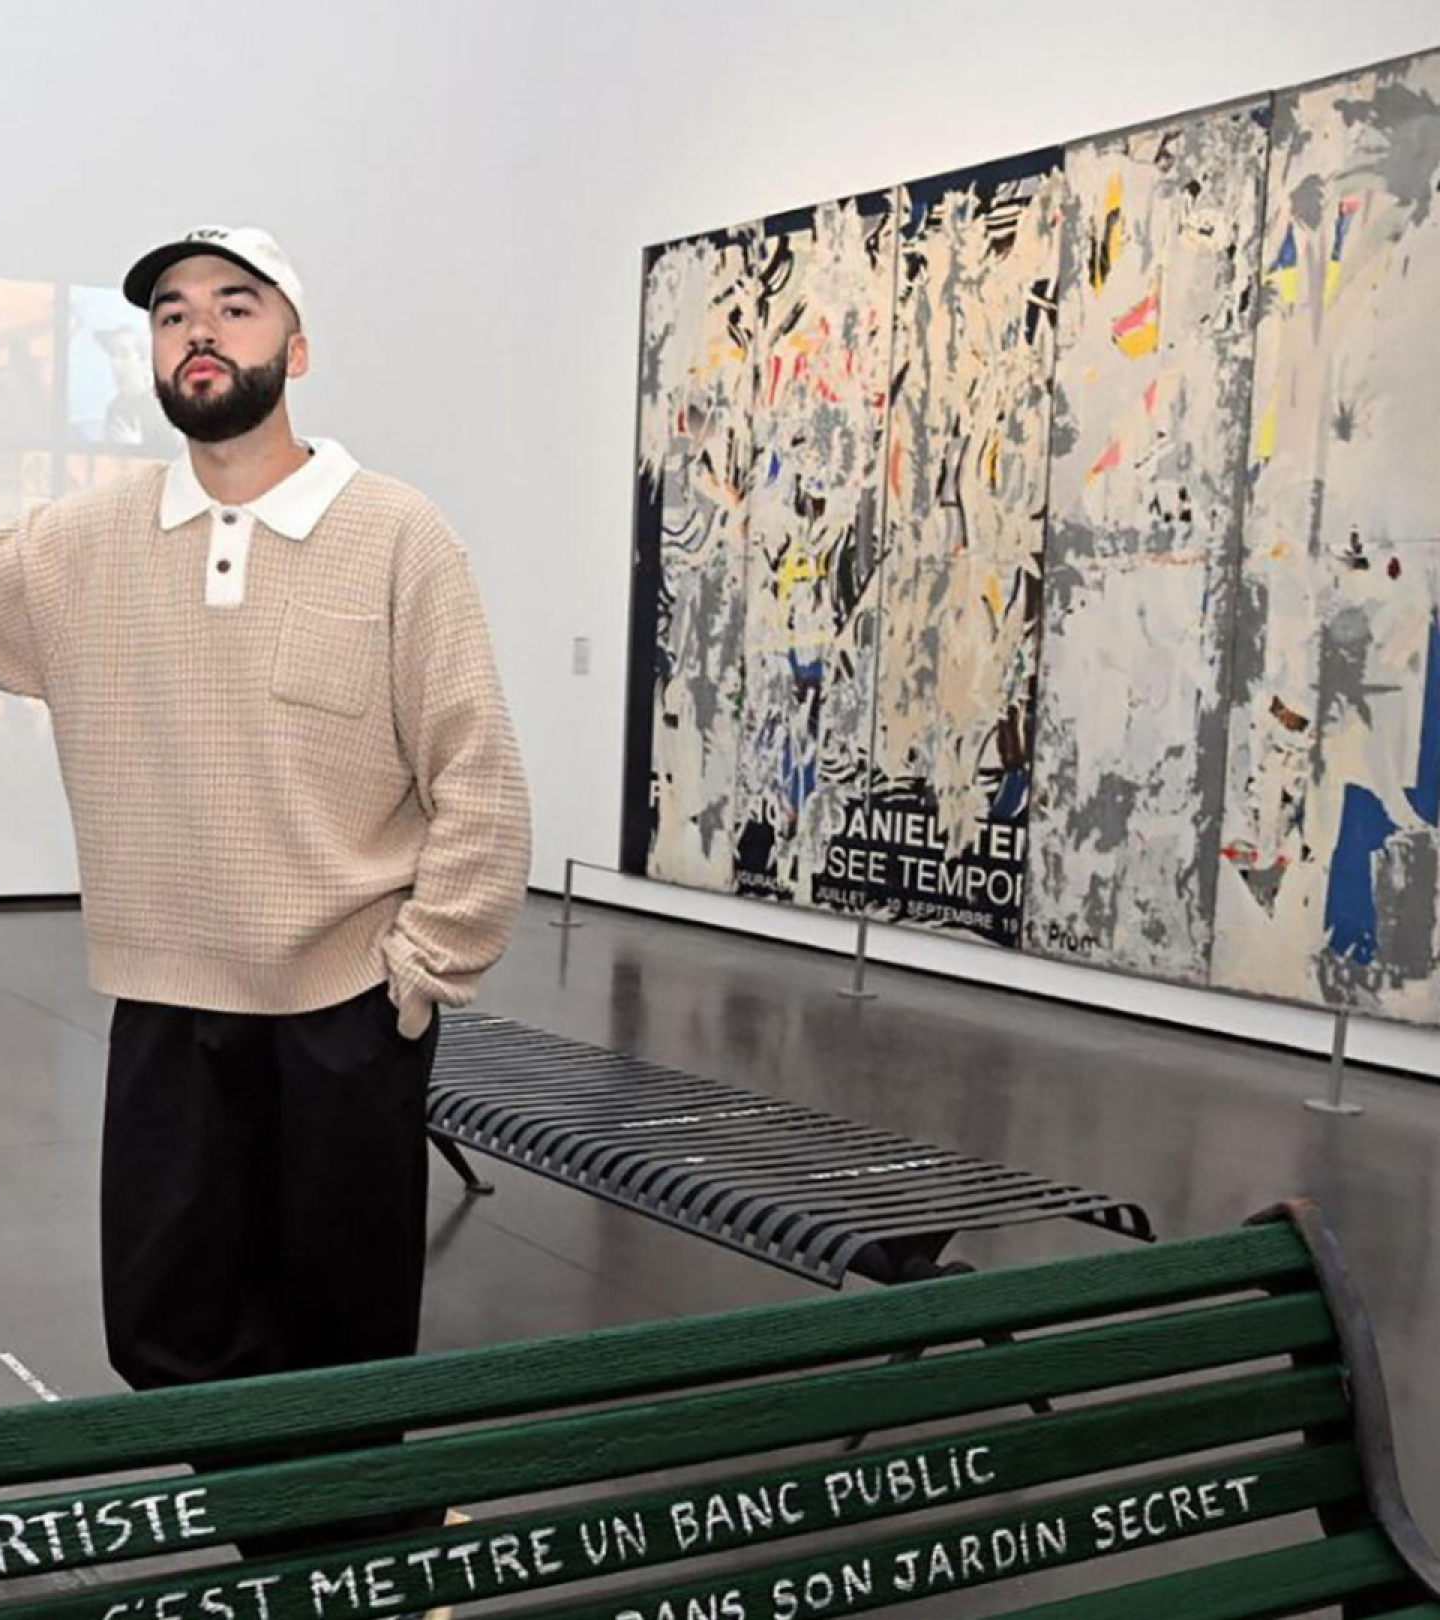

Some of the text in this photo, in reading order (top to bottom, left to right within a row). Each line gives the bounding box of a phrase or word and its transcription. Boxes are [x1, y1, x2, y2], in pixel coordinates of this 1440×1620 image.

[906, 900, 994, 931] SEPTEMBRE
[309, 1526, 563, 1618] METTRE
[579, 1511, 647, 1565] UN
[670, 1480, 806, 1550] BANC
[773, 1558, 873, 1620] SON
[1090, 1475, 1260, 1550] SECRET
